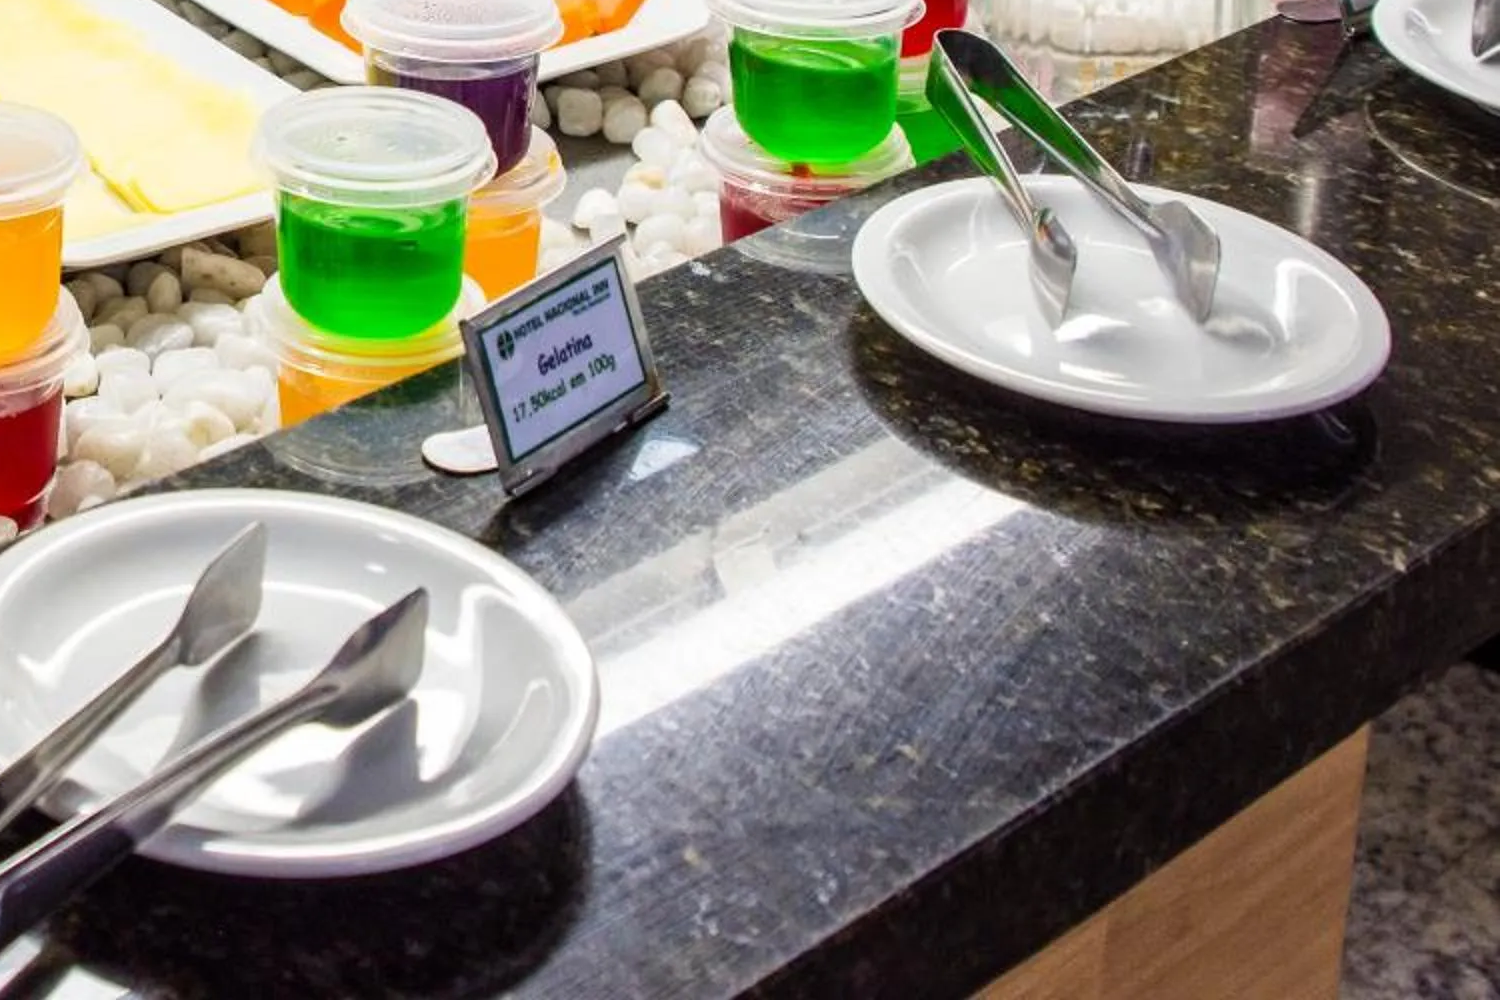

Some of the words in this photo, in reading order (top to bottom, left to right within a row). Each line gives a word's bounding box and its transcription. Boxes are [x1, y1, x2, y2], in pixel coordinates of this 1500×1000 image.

[513, 316, 544, 340] HOTEL
[544, 289, 591, 322] NACIONAL
[592, 278, 609, 295] INN
[538, 334, 593, 376] Gelatina
[570, 372, 587, 389] em
[588, 353, 616, 378] 100g
